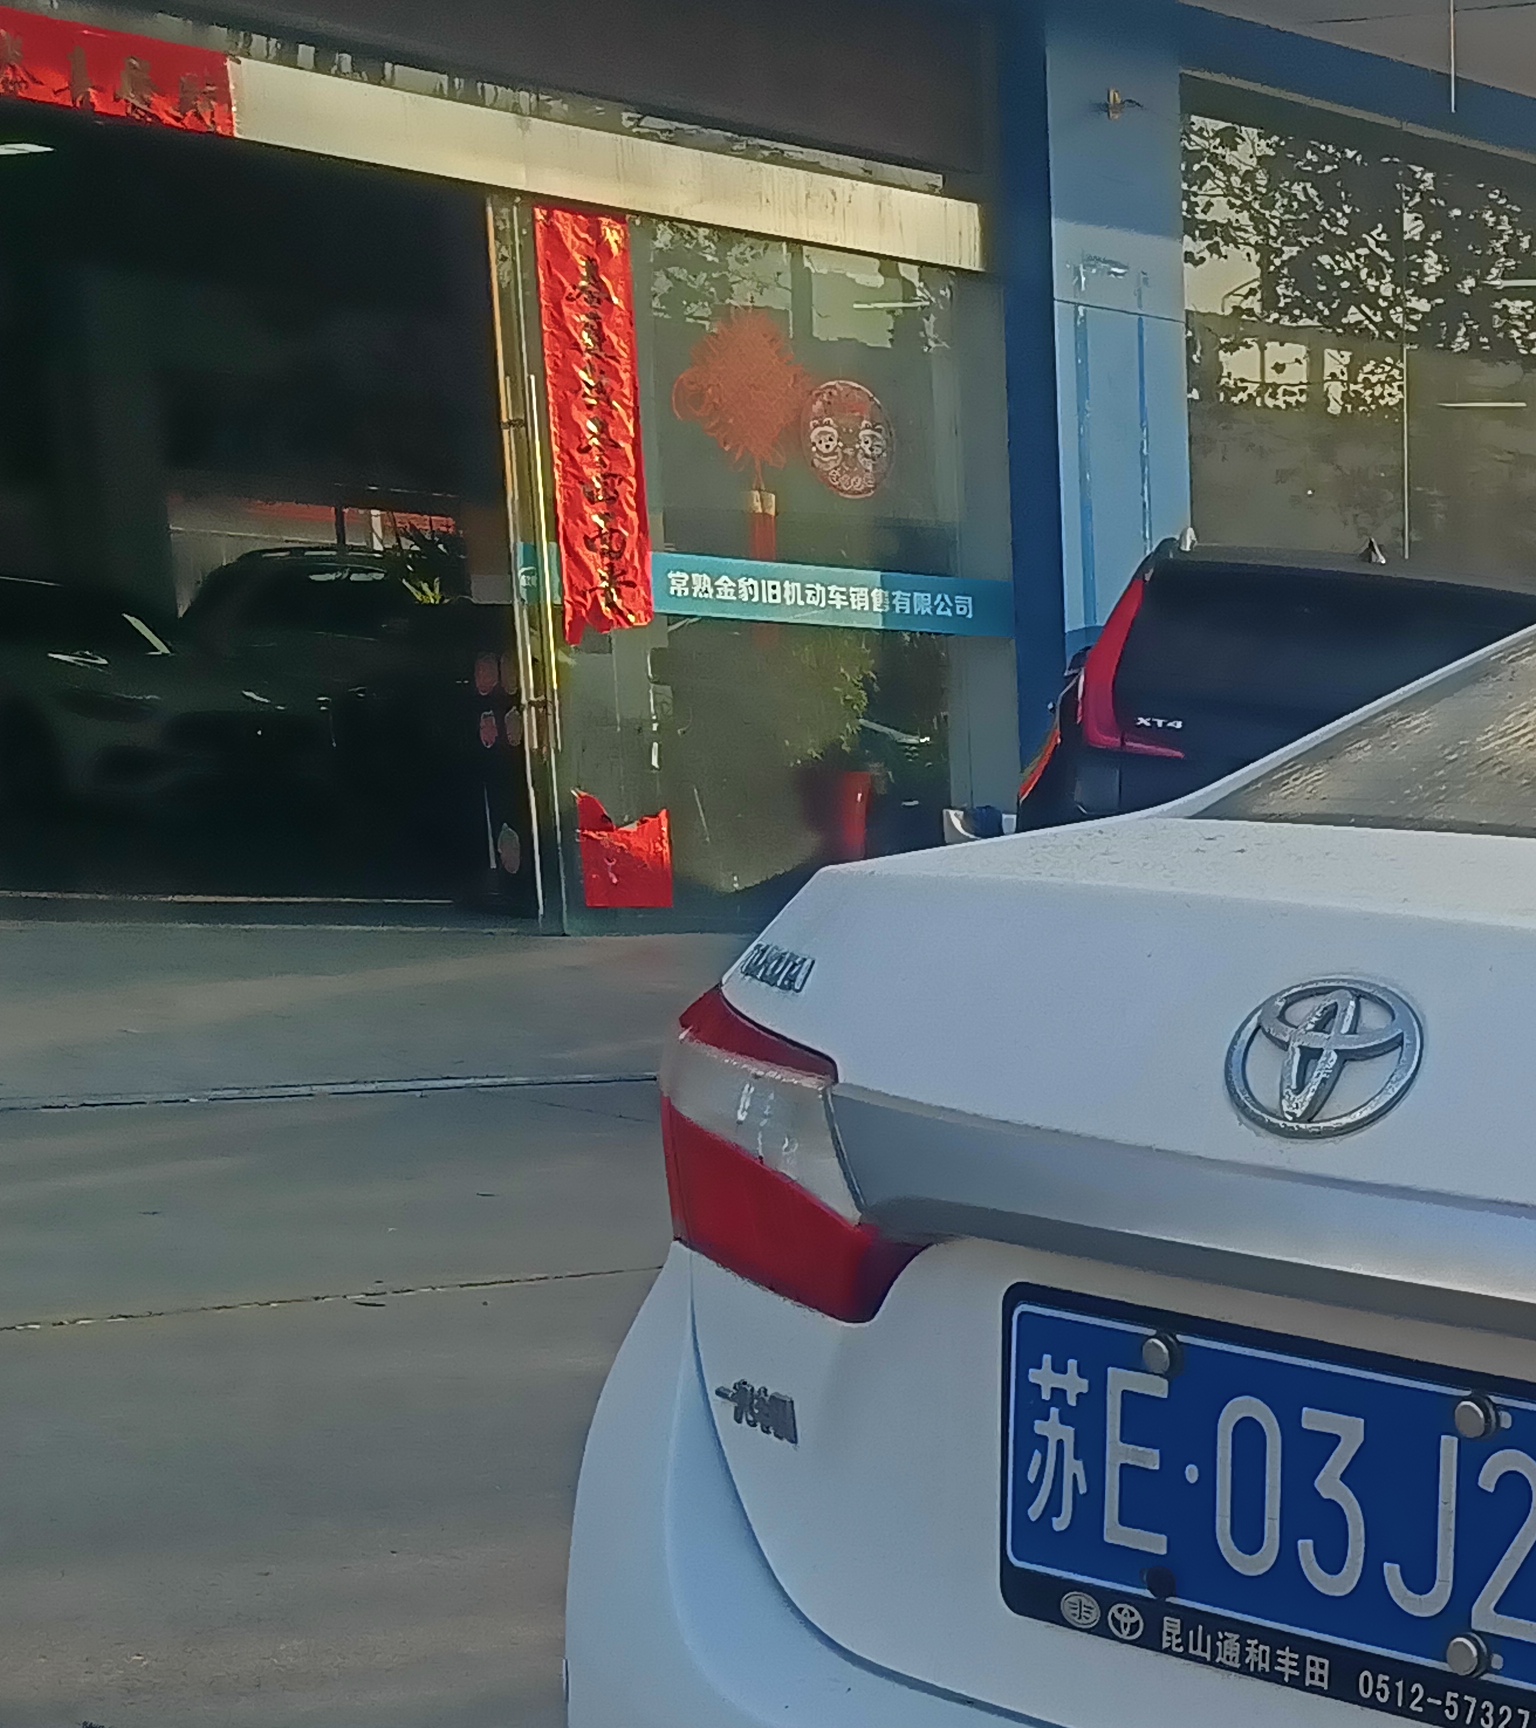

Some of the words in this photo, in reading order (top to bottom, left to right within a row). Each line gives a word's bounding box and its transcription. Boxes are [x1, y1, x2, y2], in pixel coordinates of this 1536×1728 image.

[1135, 716, 1183, 729] XT4
[1160, 1615, 1331, 1691] 昆山通和丰田
